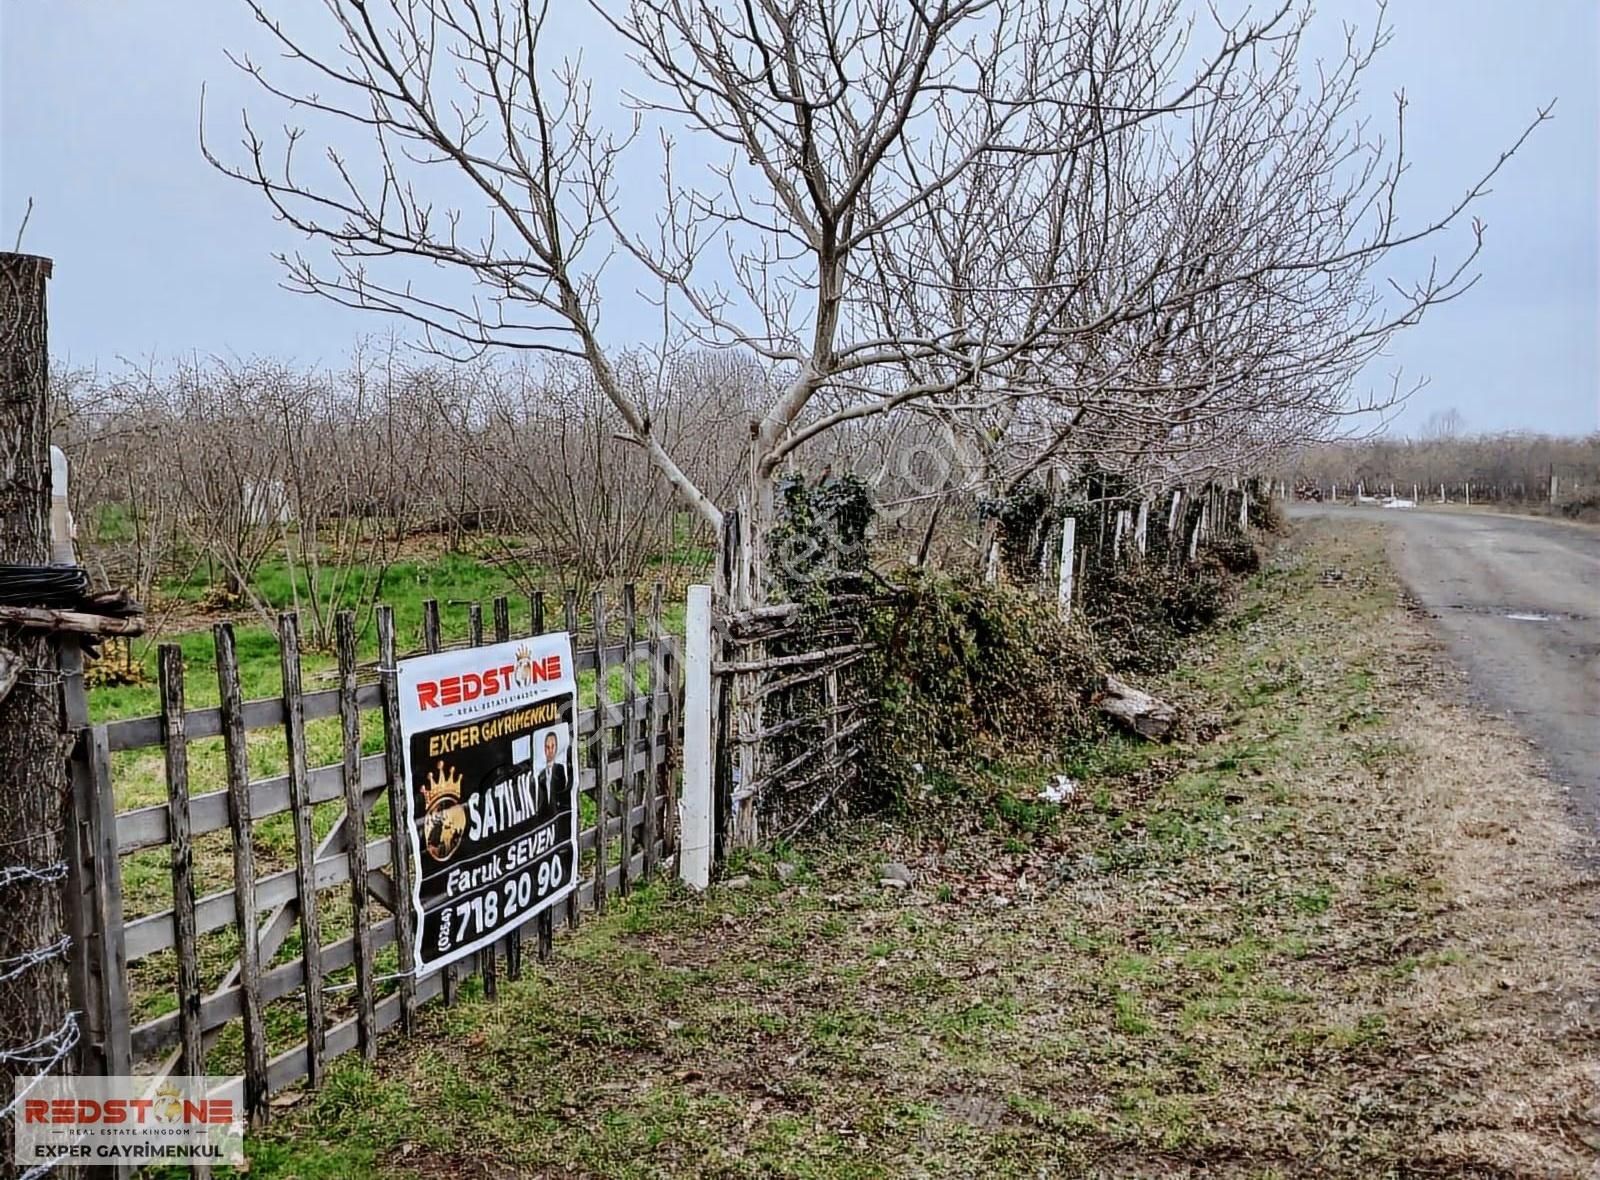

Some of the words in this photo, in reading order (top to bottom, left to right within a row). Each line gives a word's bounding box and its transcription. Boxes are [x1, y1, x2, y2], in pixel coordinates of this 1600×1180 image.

[416, 655, 562, 711] REDSTONE
[429, 725, 480, 757] EXPER
[468, 770, 536, 842] SATILIK
[446, 854, 502, 897] Faruk
[505, 823, 556, 870] SEVEN
[455, 890, 498, 943] 718
[503, 871, 532, 918] 20
[537, 853, 563, 896] 90
